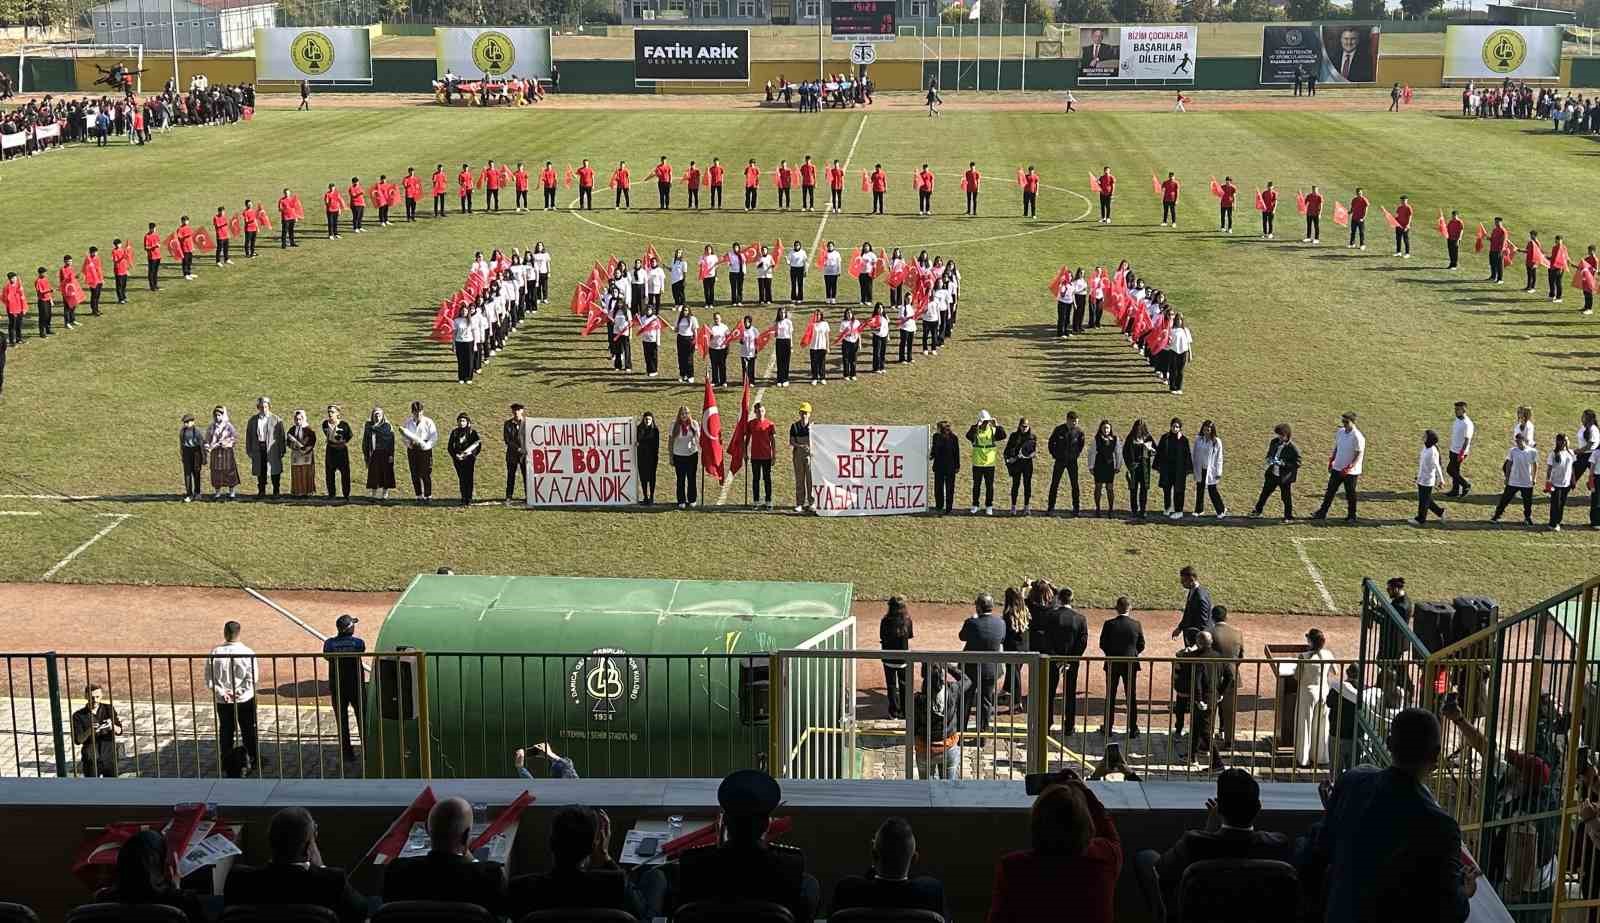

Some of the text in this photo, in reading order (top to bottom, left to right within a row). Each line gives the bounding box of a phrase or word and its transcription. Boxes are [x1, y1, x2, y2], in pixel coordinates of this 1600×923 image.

[1148, 32, 1188, 41] ÇOCUKLARA
[644, 42, 739, 58] FATİH ARİK
[1134, 43, 1182, 54] BAŞARILAR
[1138, 53, 1176, 63] DİLERİM
[850, 426, 889, 453] BİZ
[532, 447, 554, 474] BİZ
[836, 454, 904, 478] BÖYLE
[534, 475, 622, 503] KAZANDIK
